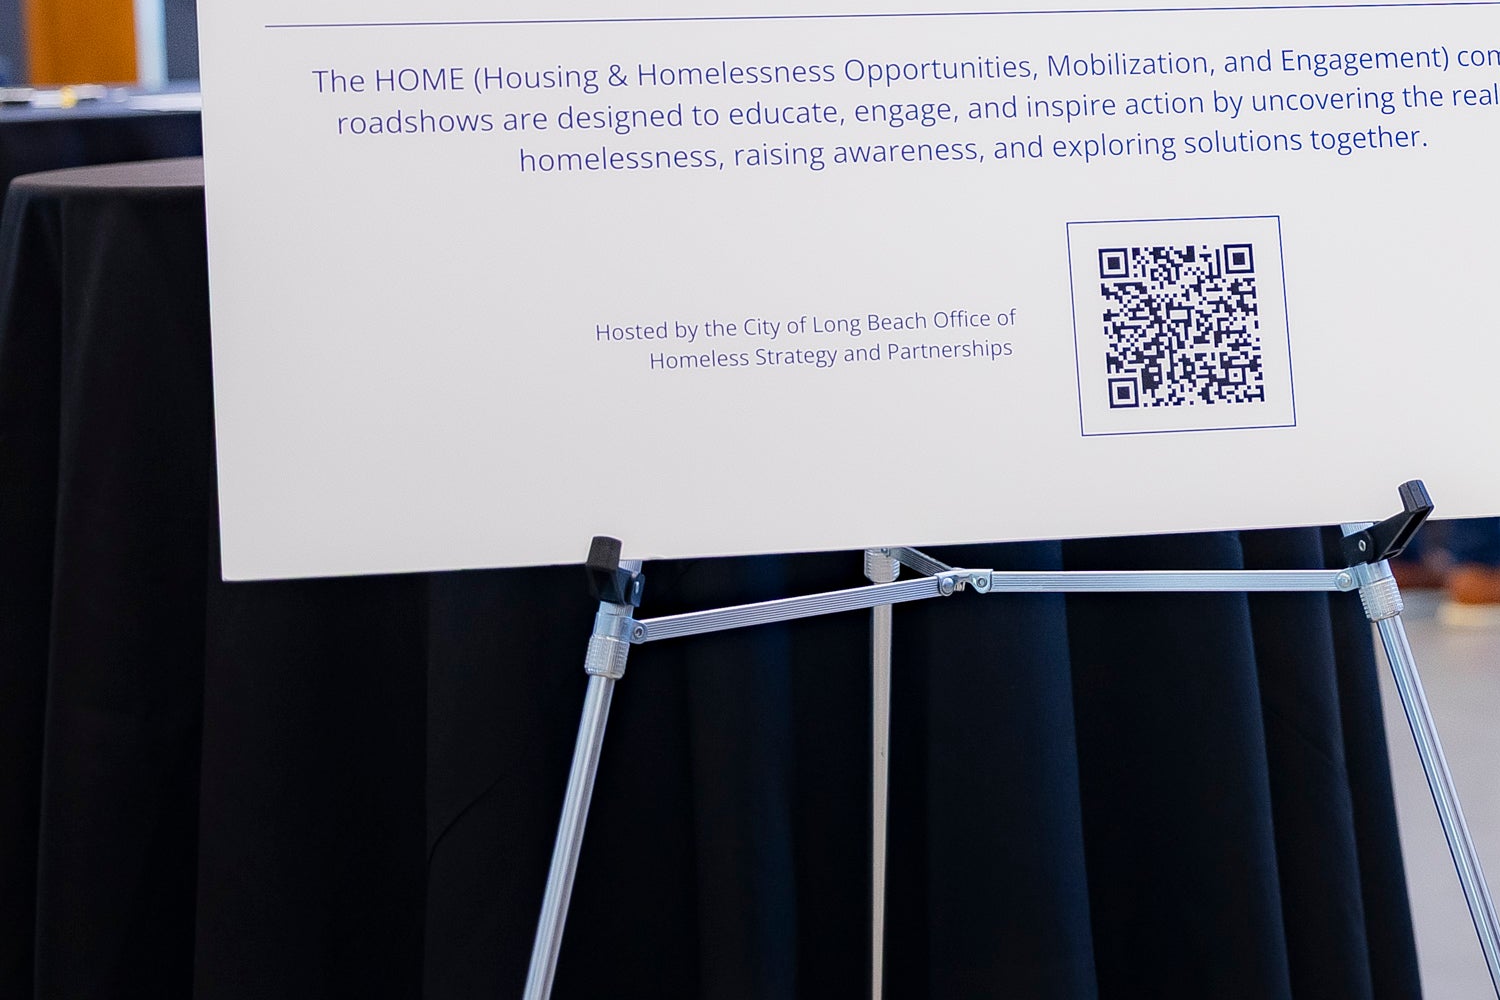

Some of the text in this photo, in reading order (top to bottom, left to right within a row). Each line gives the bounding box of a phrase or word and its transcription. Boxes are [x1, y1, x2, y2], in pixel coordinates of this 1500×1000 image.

[311, 68, 365, 94] The
[375, 67, 465, 92] HOME
[474, 64, 600, 95] (Housing
[608, 63, 629, 87] &
[638, 60, 836, 87] Homelessness
[844, 55, 1038, 89] Opportunities,
[1047, 51, 1215, 77] Mobilization,
[1224, 48, 1272, 73] and
[1281, 45, 1449, 78] Engagement)
[338, 108, 494, 135] roadshows
[503, 112, 548, 131] are
[557, 102, 683, 136] designed
[691, 105, 720, 127] to
[729, 100, 845, 127] educate,
[854, 102, 959, 129] engage,
[968, 94, 1017, 120] and
[1026, 93, 1116, 124] inspire
[1125, 91, 1204, 116] action
[1213, 89, 1244, 120] by
[1251, 86, 1396, 115] uncovering
[1401, 84, 1444, 108] the
[519, 124, 1428, 173] homelessness, raising awareness, and exploring solutions together.
[596, 307, 1017, 344] Hosted by the City of Long Beach Office of
[650, 339, 1013, 370] Homeless Strategy and Partnerships
